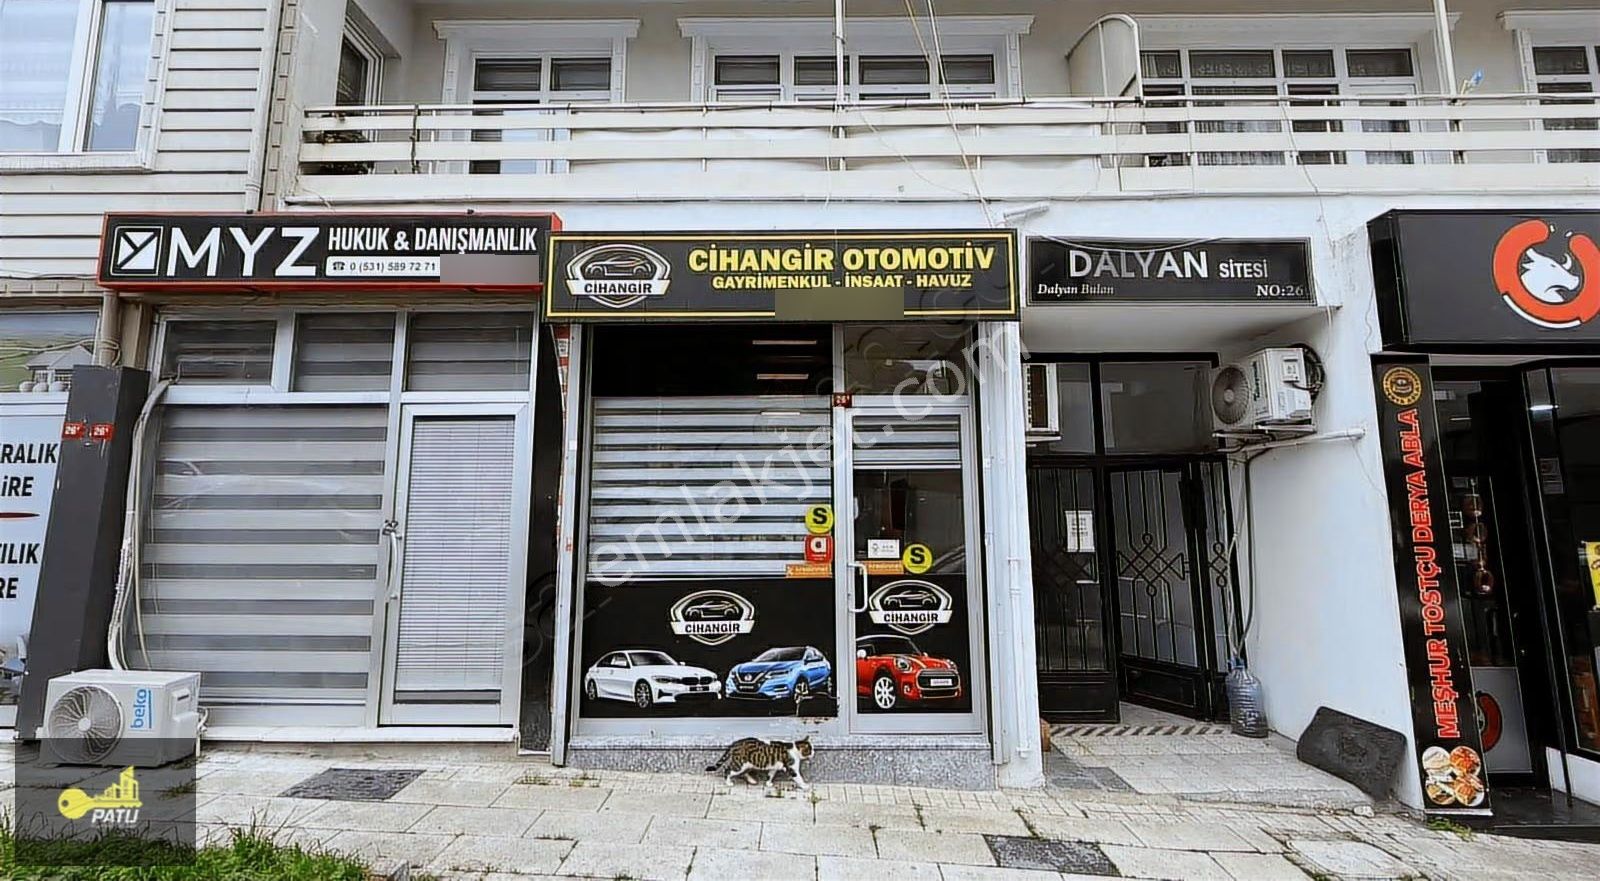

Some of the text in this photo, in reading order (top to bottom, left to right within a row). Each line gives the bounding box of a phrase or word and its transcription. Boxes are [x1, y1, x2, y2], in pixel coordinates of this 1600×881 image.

[167, 226, 318, 277] MYZ
[328, 227, 538, 254] HUKUK & DANIŞMANLIK
[350, 262, 436, 273] 0 (531) 589 72 71
[688, 242, 995, 272] CİHANGİR OTOMOTİV
[1068, 249, 1268, 279] DALYAN SİTESİ
[712, 272, 832, 289] GAYRİMENKUL
[916, 274, 972, 288] HAVUZ
[1037, 282, 1078, 298] Dalyan
[1397, 408, 1425, 468] ABLA
[0, 443, 58, 464] RALIK
[812, 507, 828, 525] S
[1406, 470, 1434, 543] DERYA
[0, 543, 40, 564] ILIK
[909, 546, 926, 565] S
[1414, 546, 1447, 636] TOSTÇU
[1425, 639, 1461, 739] MEŞHUR
[130, 689, 147, 728] beko
